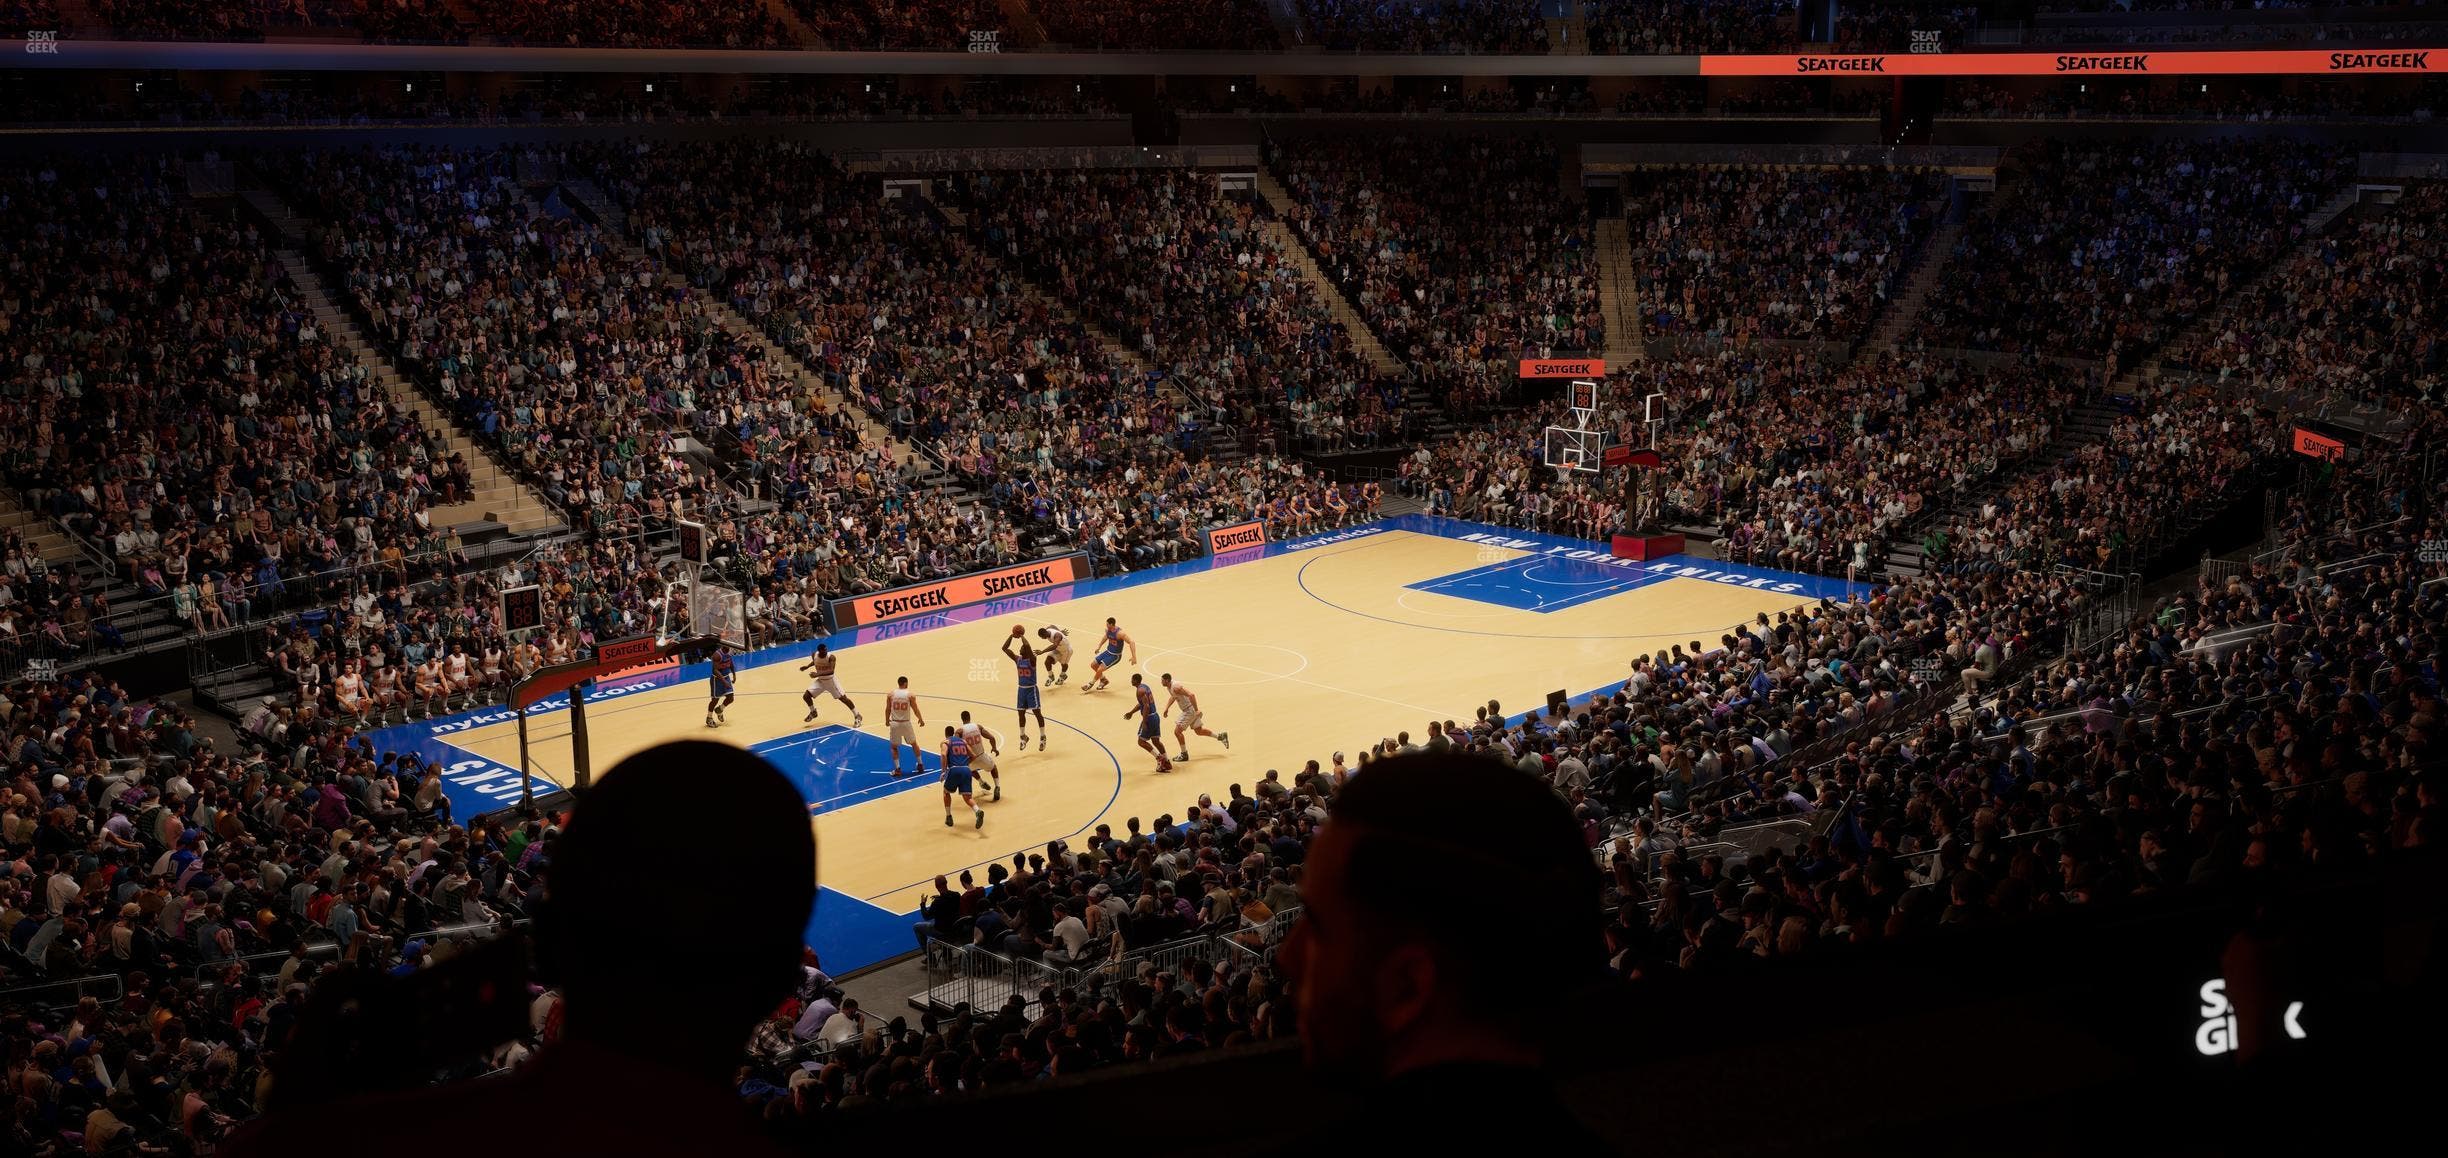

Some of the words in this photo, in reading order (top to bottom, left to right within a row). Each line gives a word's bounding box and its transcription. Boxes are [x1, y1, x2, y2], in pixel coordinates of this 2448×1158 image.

[1797, 57, 1885, 72] SEATGEEK
[2056, 55, 2148, 71] SEATGEEK
[2329, 52, 2429, 69] SEATGEEK
[1535, 364, 1590, 375] SEATGEEK
[1214, 527, 1263, 550] SEATGEEK
[1457, 532, 1542, 549] NEW
[1544, 545, 1641, 567] YORK
[1645, 562, 1803, 592] KNICKS
[873, 587, 949, 618] SEATGEEK
[983, 566, 1052, 596] SEATGEEK
[605, 642, 649, 659] SEATGEEK
